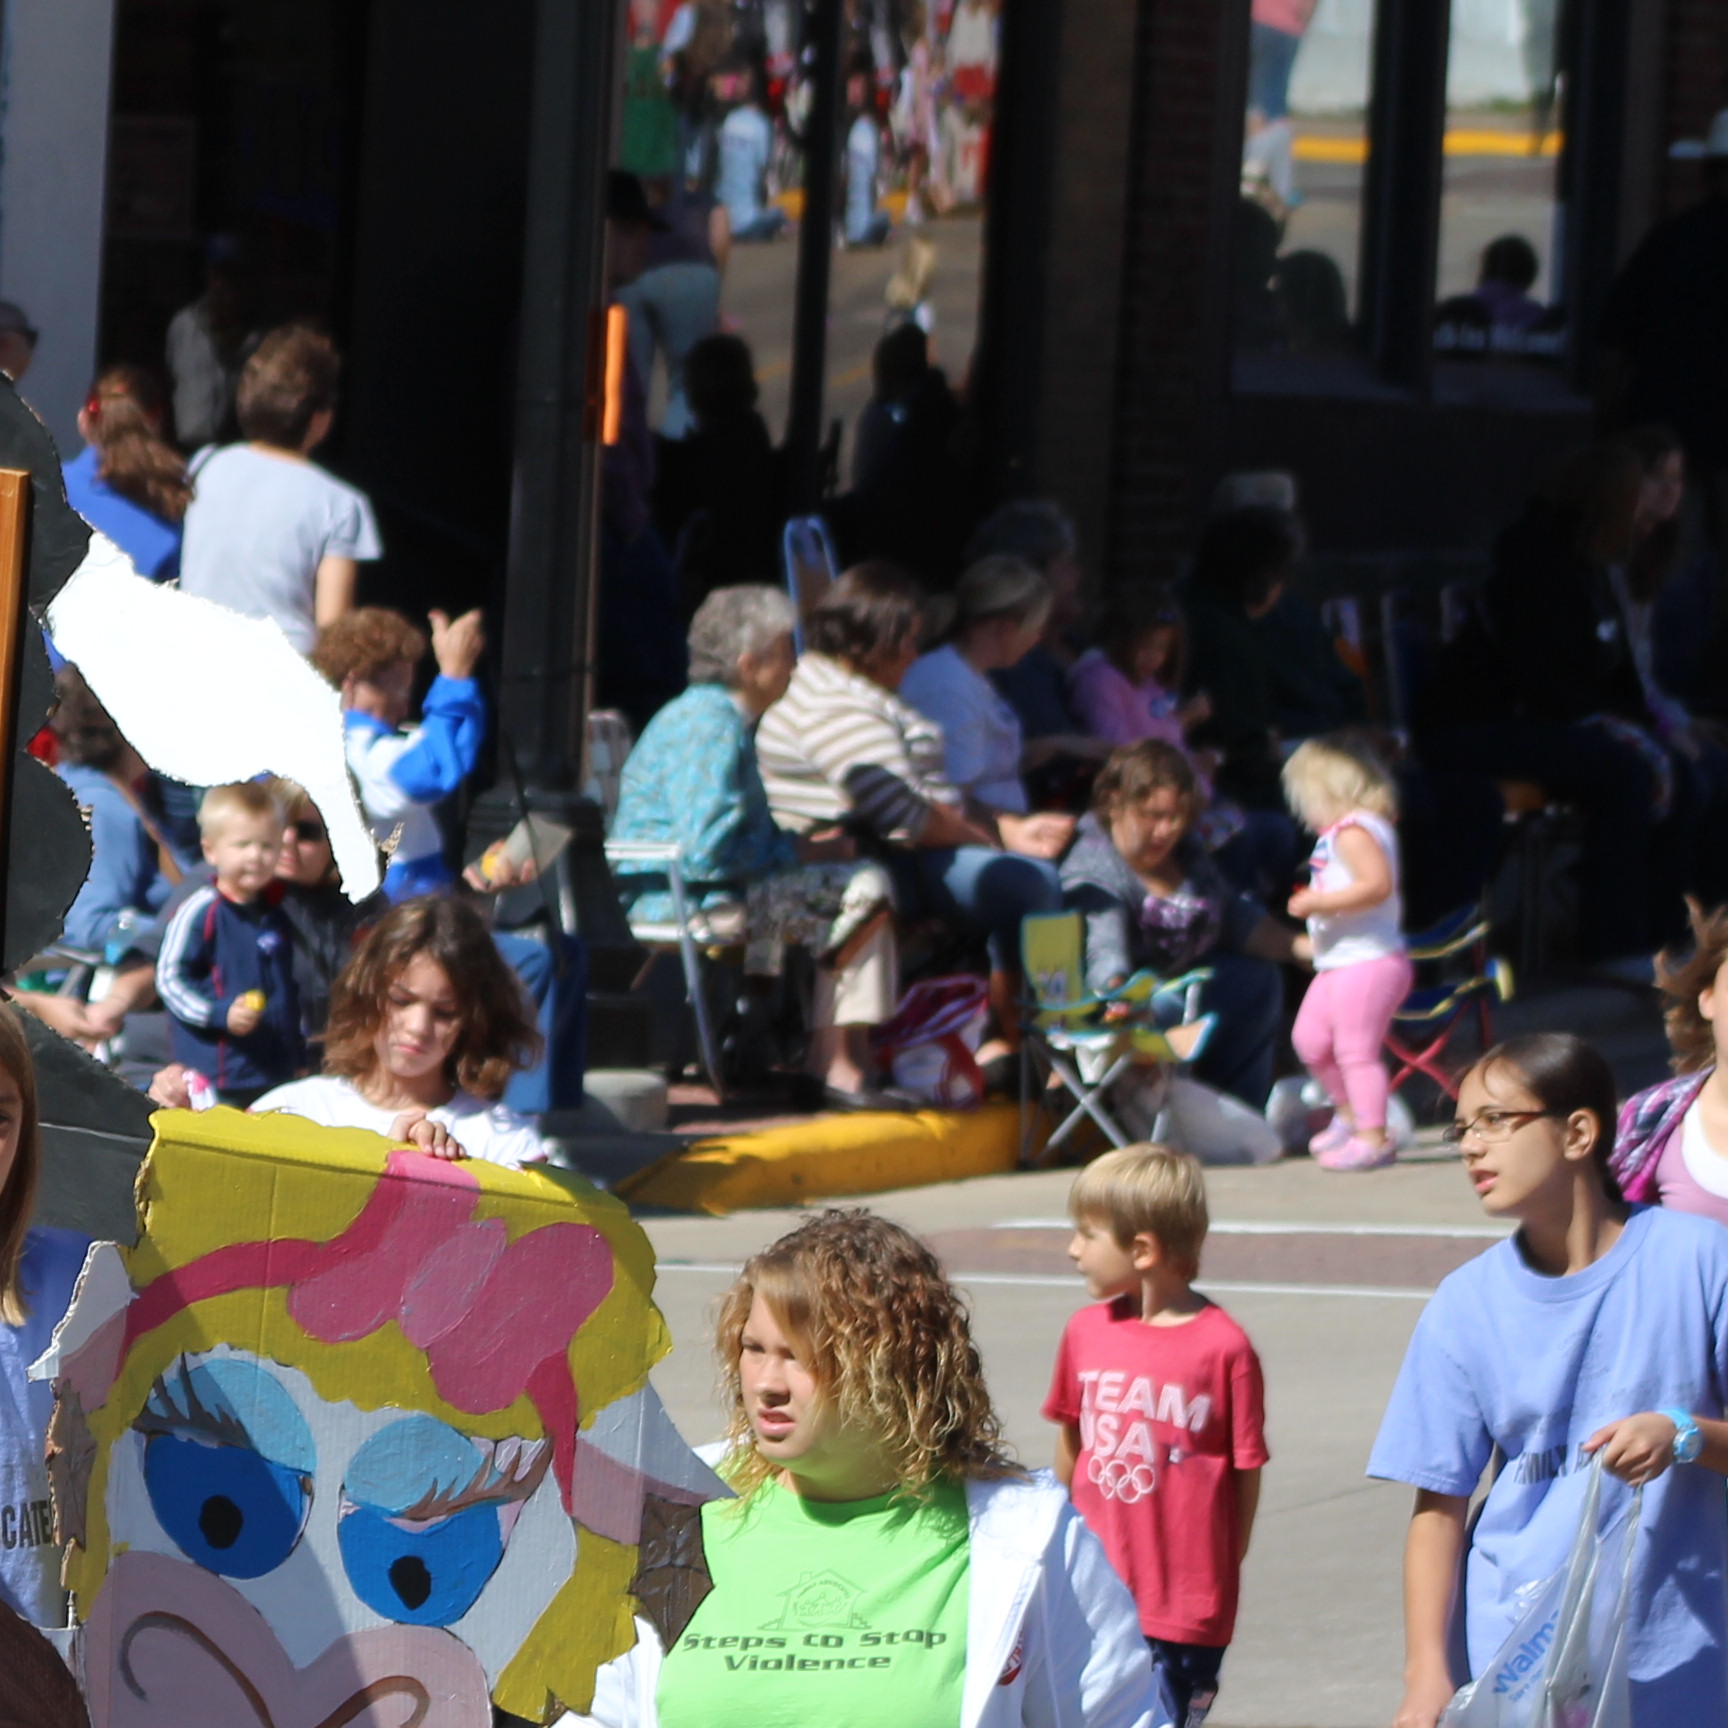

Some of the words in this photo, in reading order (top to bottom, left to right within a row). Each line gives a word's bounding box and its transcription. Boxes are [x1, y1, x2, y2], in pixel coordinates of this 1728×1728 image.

[1077, 1369, 1214, 1434] TEAM
[1079, 1408, 1156, 1464] USA
[682, 1632, 787, 1652] Steps
[802, 1631, 844, 1649] to
[859, 1628, 947, 1649] Stop
[723, 1654, 892, 1672] Violence
[1491, 1609, 1561, 1698] Walm
